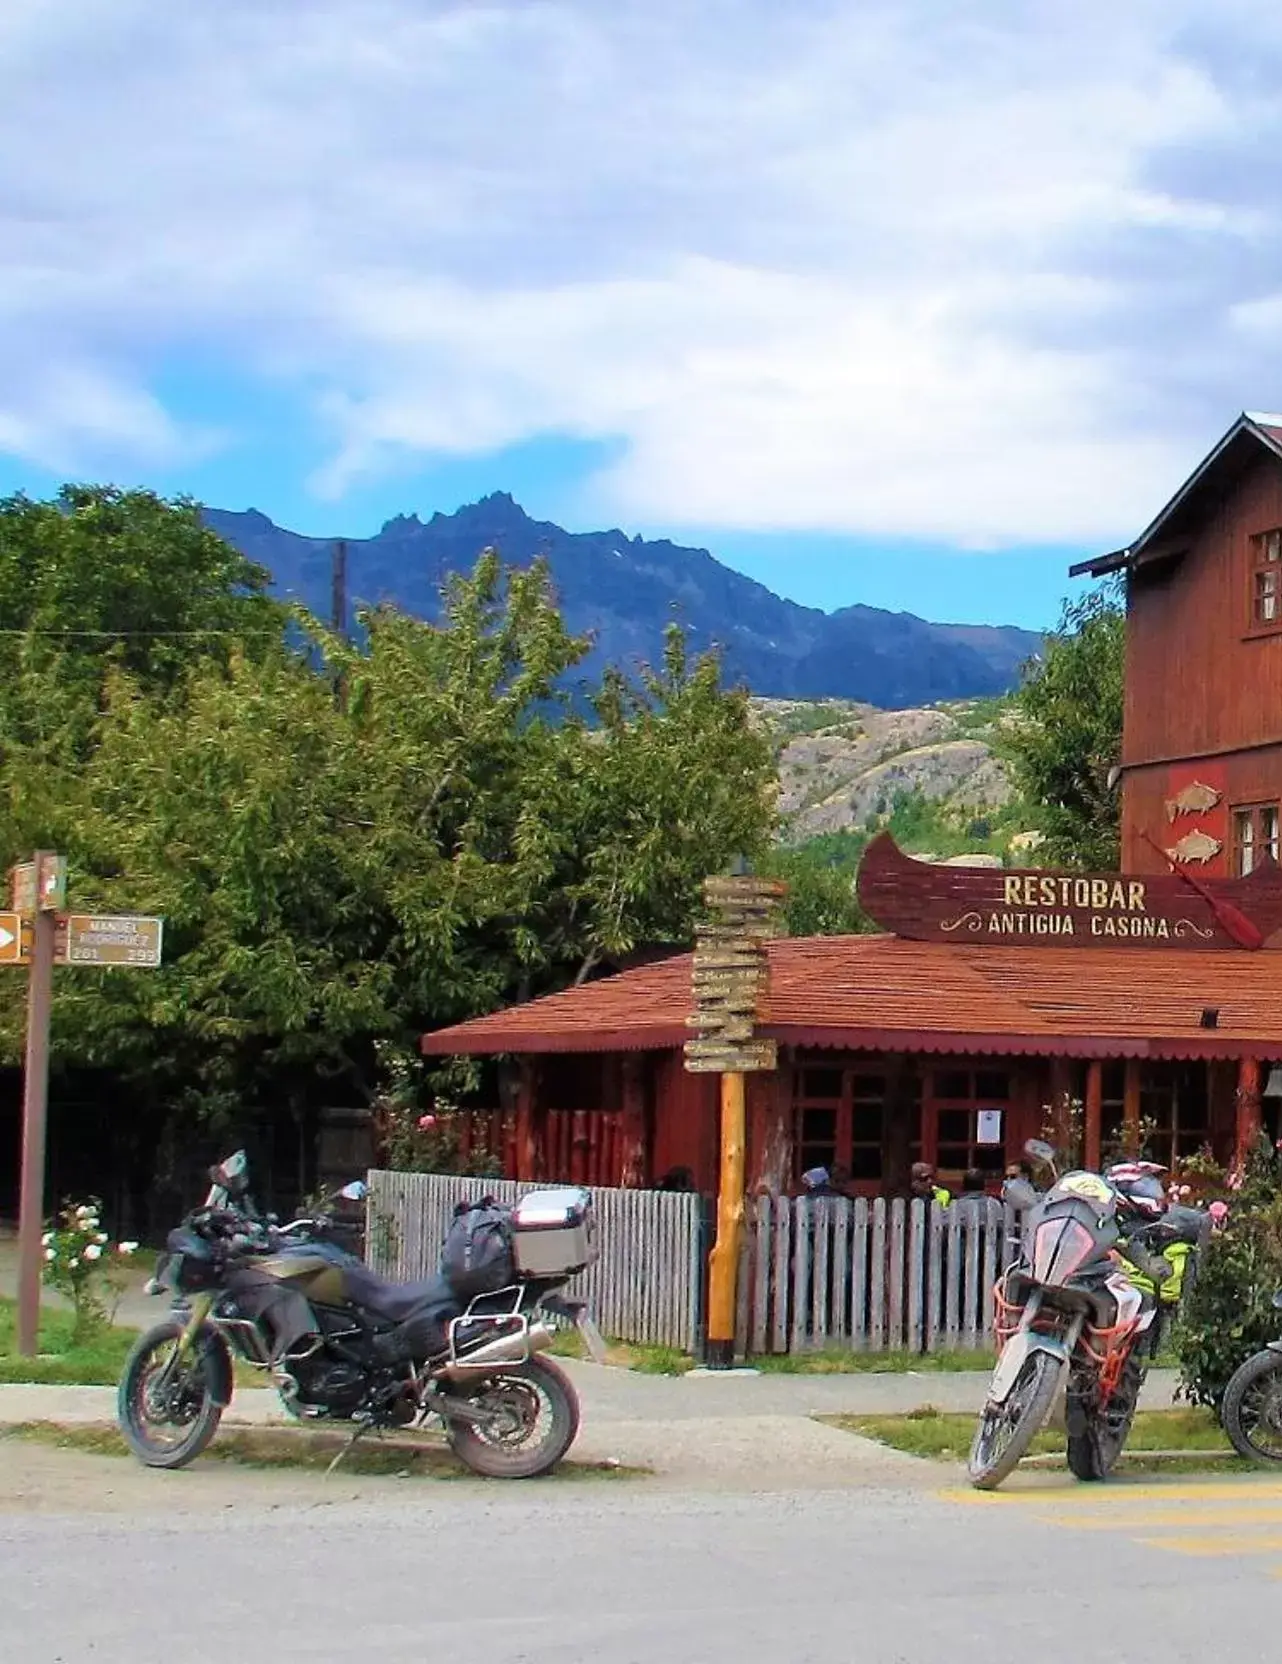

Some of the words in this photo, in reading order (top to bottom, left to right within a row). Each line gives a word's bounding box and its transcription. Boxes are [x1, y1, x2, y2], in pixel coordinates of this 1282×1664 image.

[1003, 875, 1145, 911] RESTOBAR
[988, 913, 1074, 935] ANTIGUA
[1091, 915, 1169, 938] CASONA
